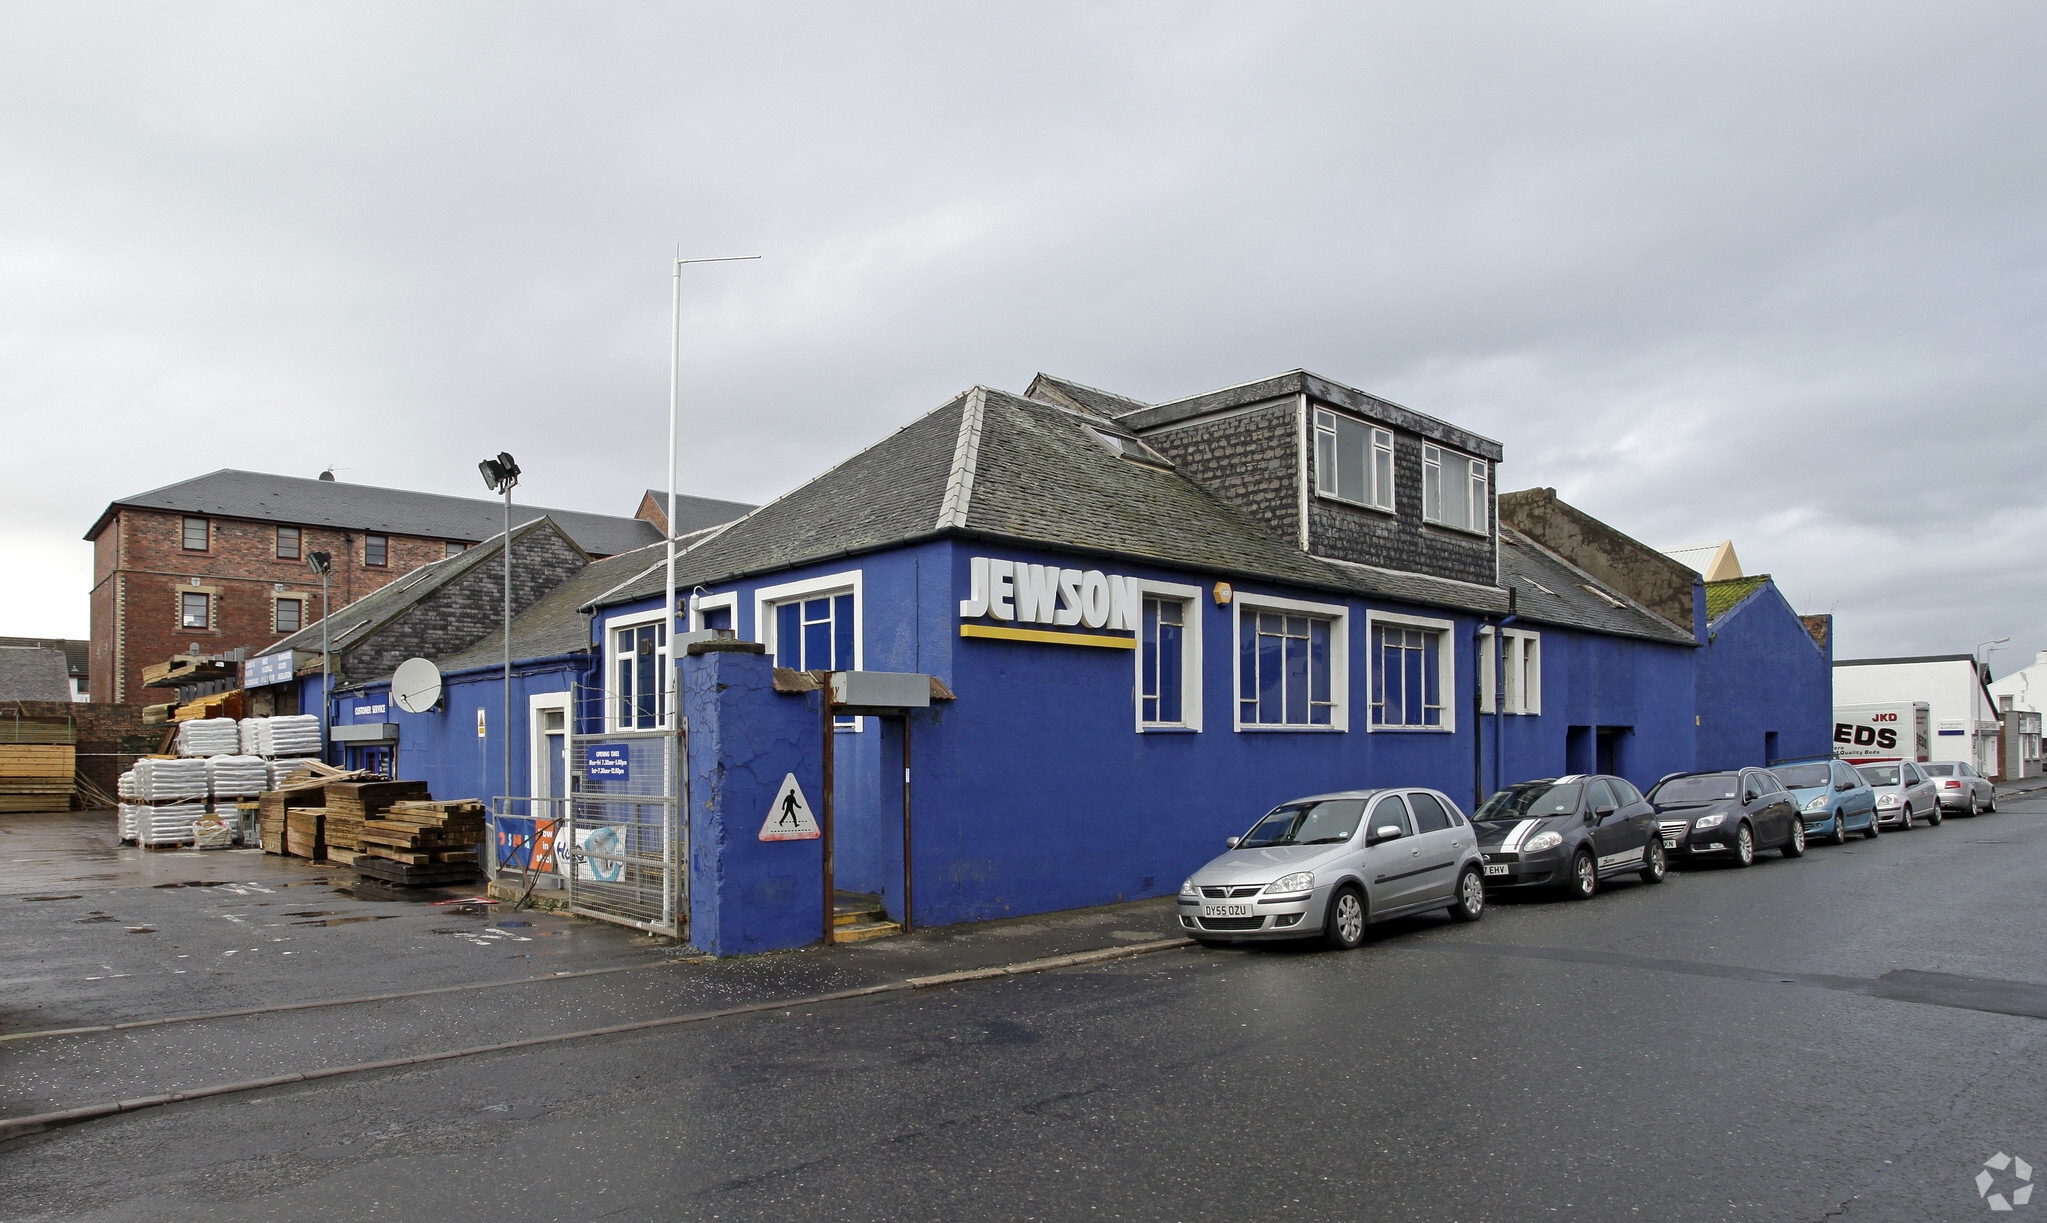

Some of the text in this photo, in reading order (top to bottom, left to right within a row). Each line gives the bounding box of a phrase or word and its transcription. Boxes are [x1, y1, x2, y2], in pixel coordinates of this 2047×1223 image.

[960, 557, 1138, 631] JEWSON
[1872, 713, 1897, 722] JKD
[542, 841, 549, 850] in
[1206, 906, 1246, 915] DY55 OZU
